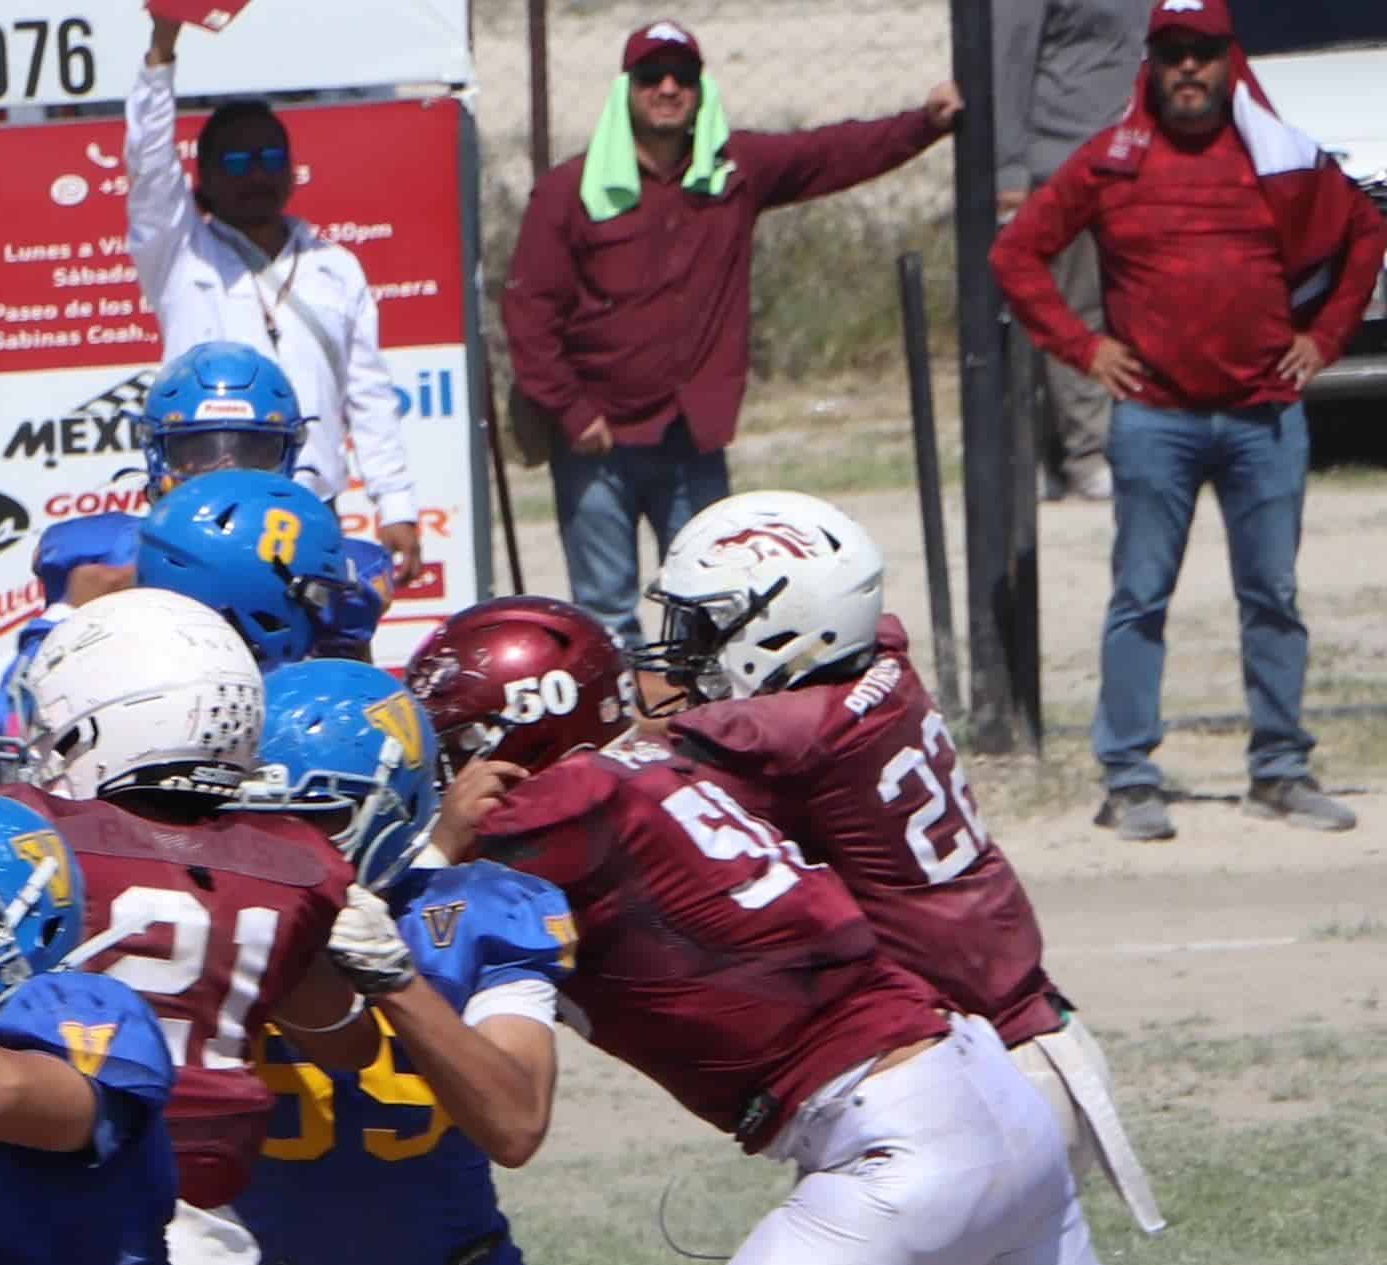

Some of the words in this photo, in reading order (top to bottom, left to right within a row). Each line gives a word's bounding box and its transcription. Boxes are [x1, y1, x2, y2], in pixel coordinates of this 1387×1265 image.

[4, 243, 72, 263] Lunes
[64, 300, 93, 320] de
[257, 507, 302, 567] 8
[503, 669, 579, 726] 50
[420, 900, 468, 949] V
[57, 1019, 121, 1078] V
